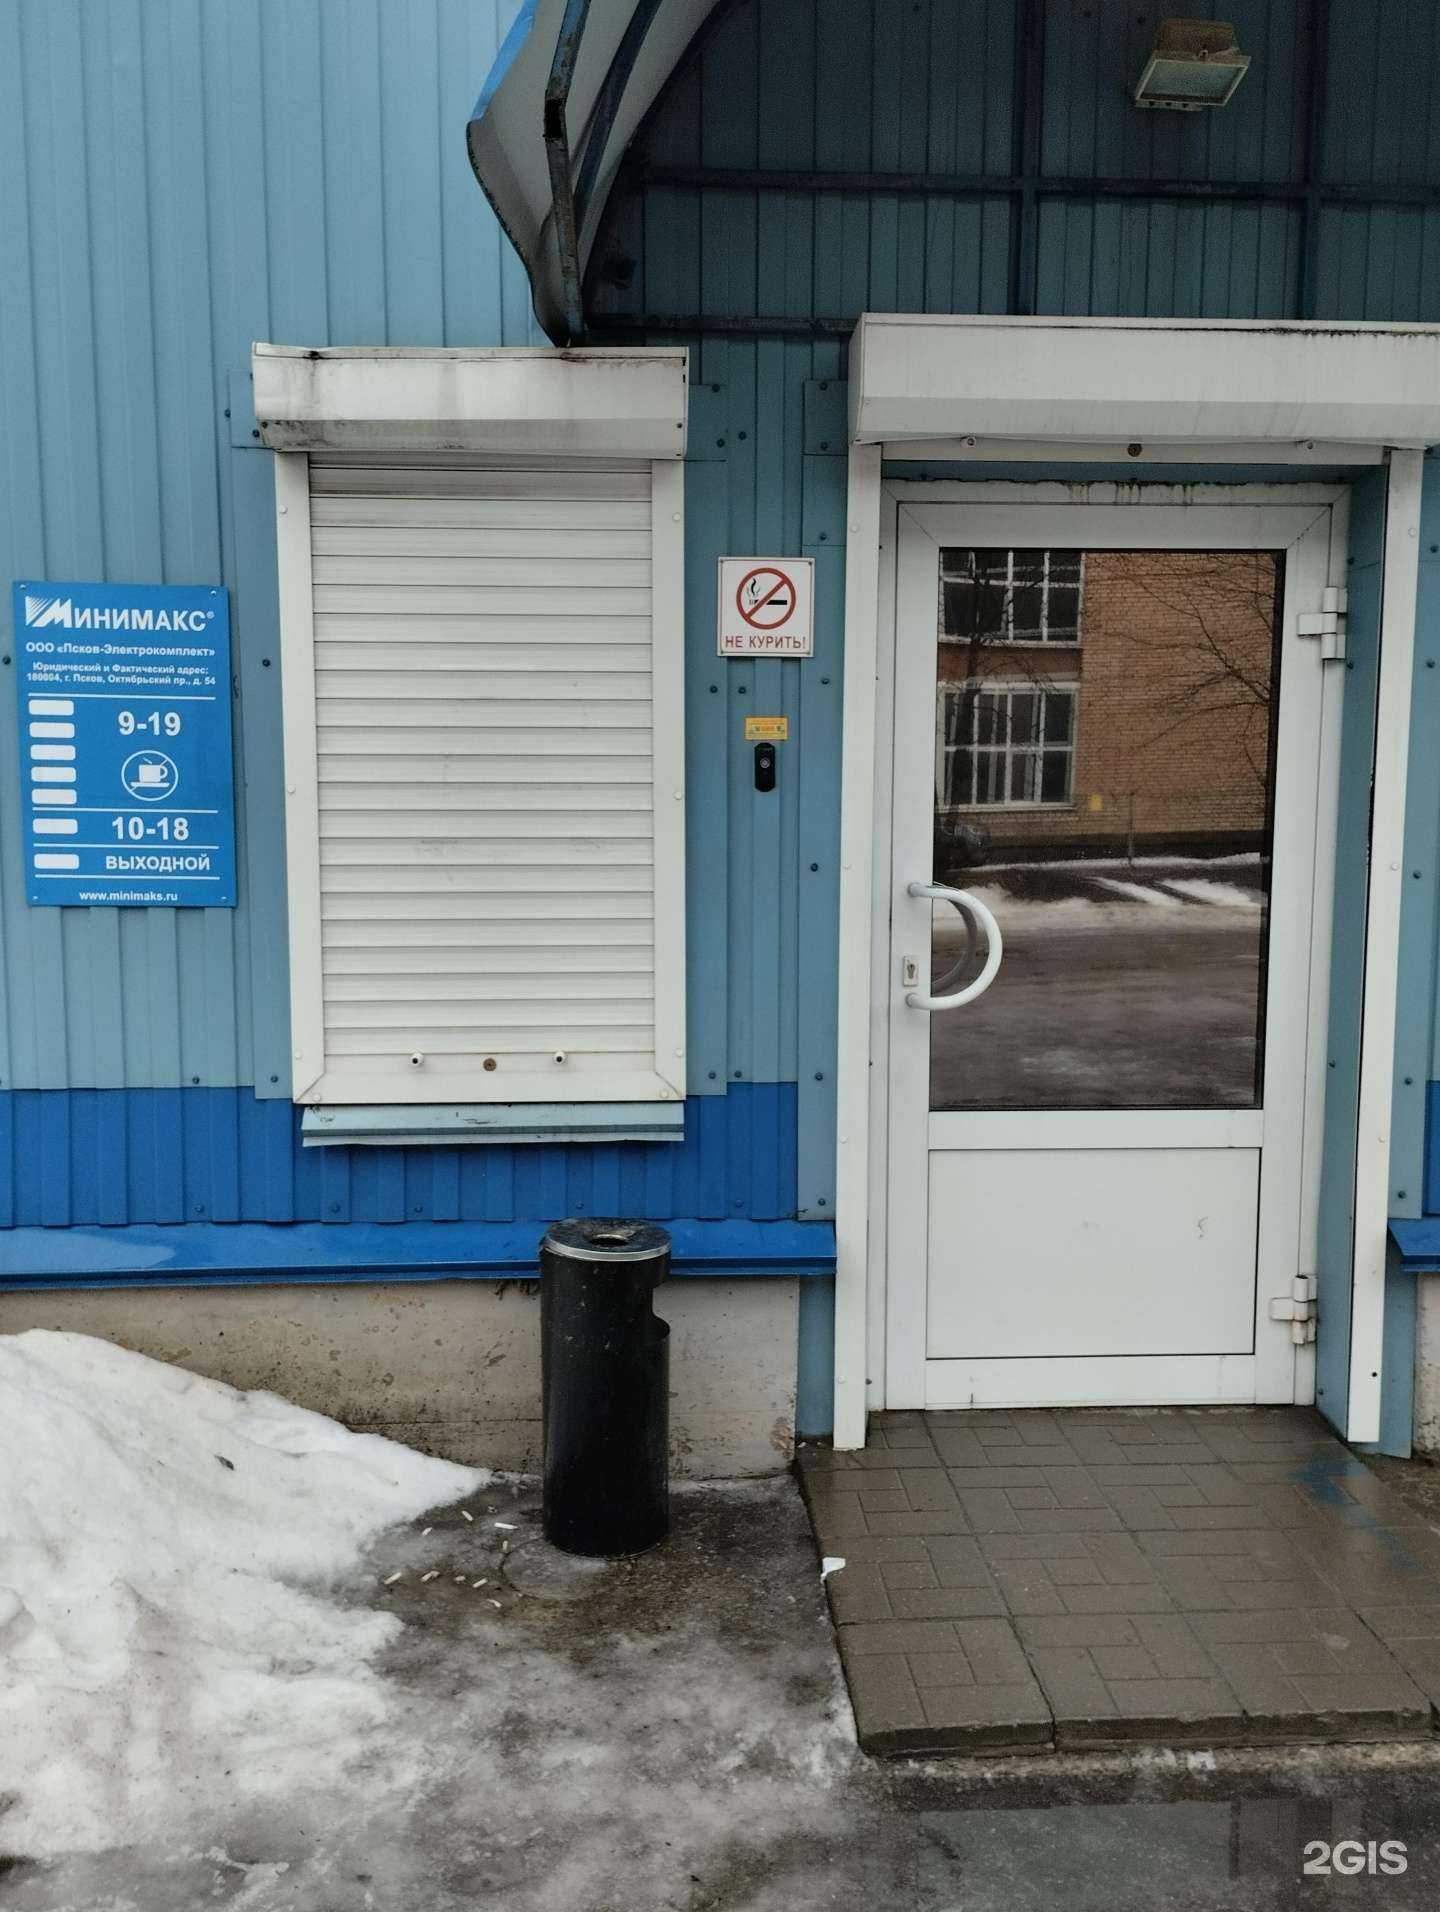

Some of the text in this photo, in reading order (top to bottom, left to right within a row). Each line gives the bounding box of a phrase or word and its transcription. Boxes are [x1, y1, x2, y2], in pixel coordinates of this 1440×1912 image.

[25, 641, 215, 657] ООО «Псков-Электрокомплект»
[725, 635, 806, 649] НЕ КУРИТЬ!
[32, 662, 102, 672] Юридический
[112, 664, 175, 674] Фактический
[177, 667, 209, 676] адрес:
[107, 674, 171, 685] Октябрьский
[118, 711, 181, 737] 9-19
[111, 816, 189, 841] 10-18
[105, 853, 210, 872] ВЫХОДНОЙ
[79, 891, 178, 901] www.minimaks.ru
